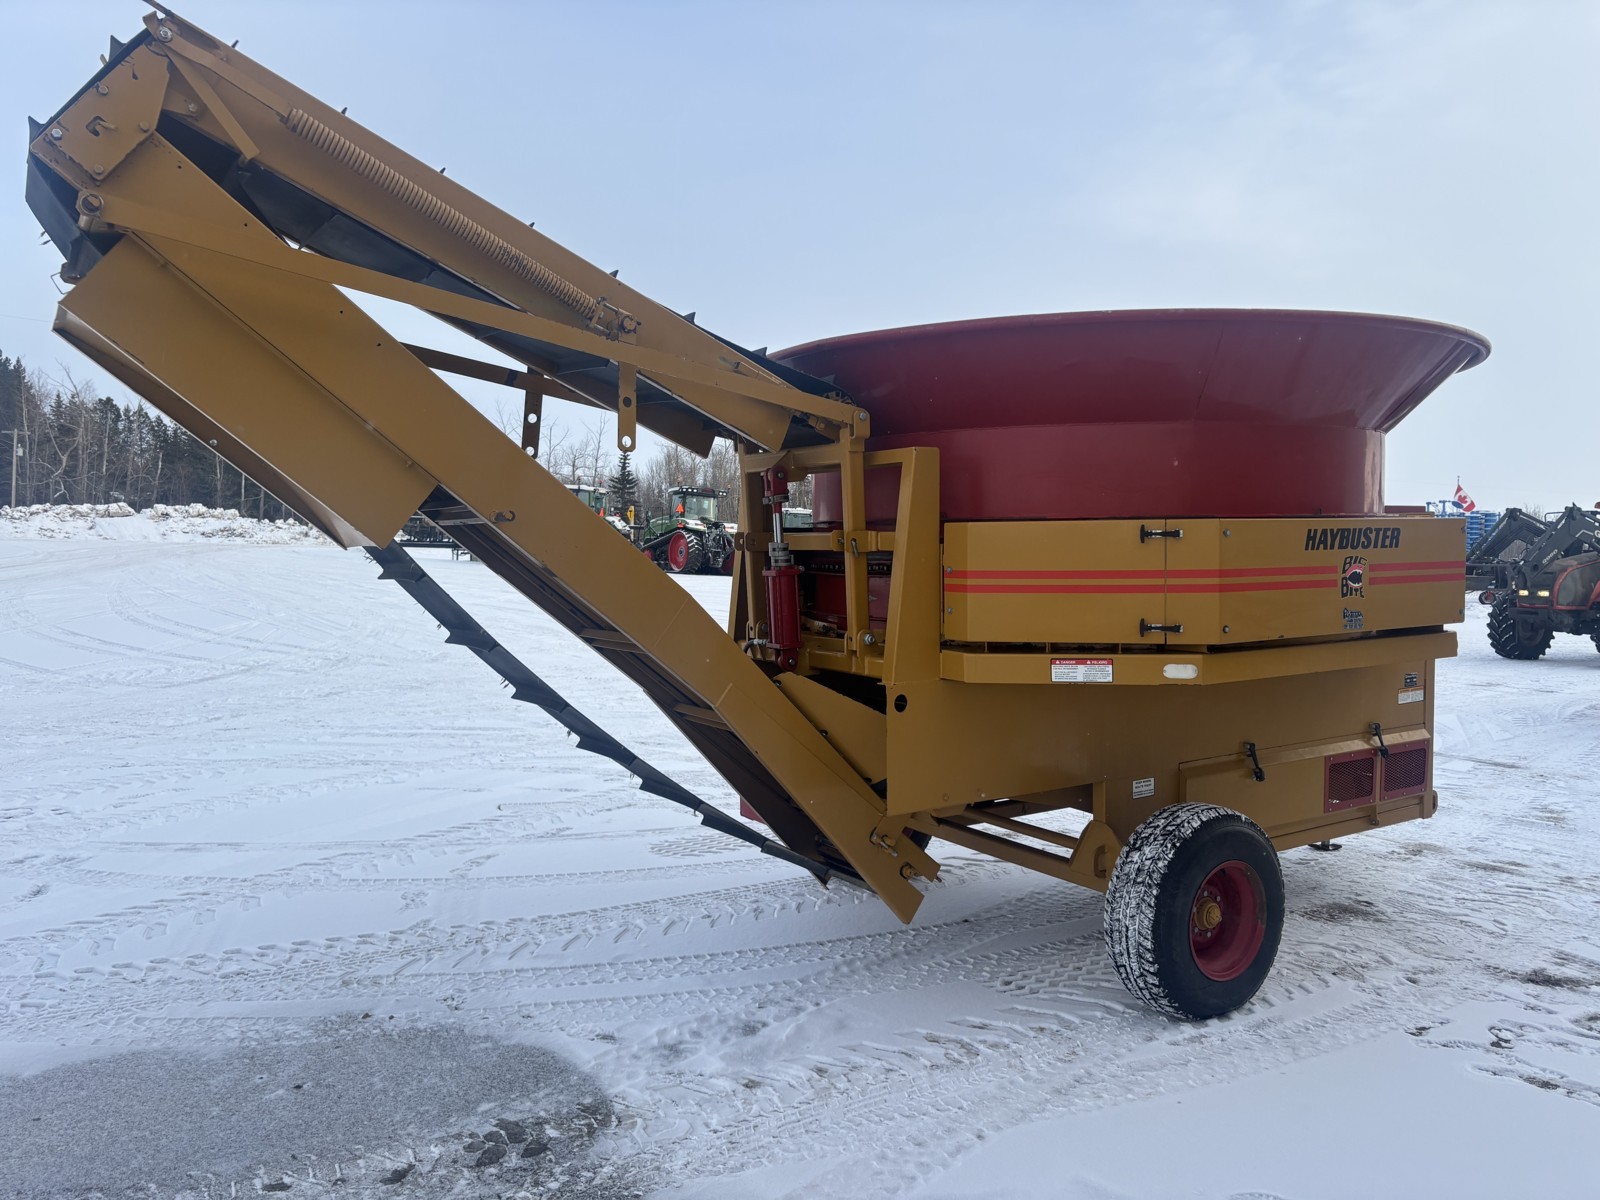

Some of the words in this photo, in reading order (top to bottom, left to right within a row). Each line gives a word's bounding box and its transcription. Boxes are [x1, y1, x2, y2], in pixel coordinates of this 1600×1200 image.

[1304, 527, 1401, 551] HAYBUSTER
[1342, 555, 1367, 575] BIG
[1341, 576, 1364, 599] BITE
